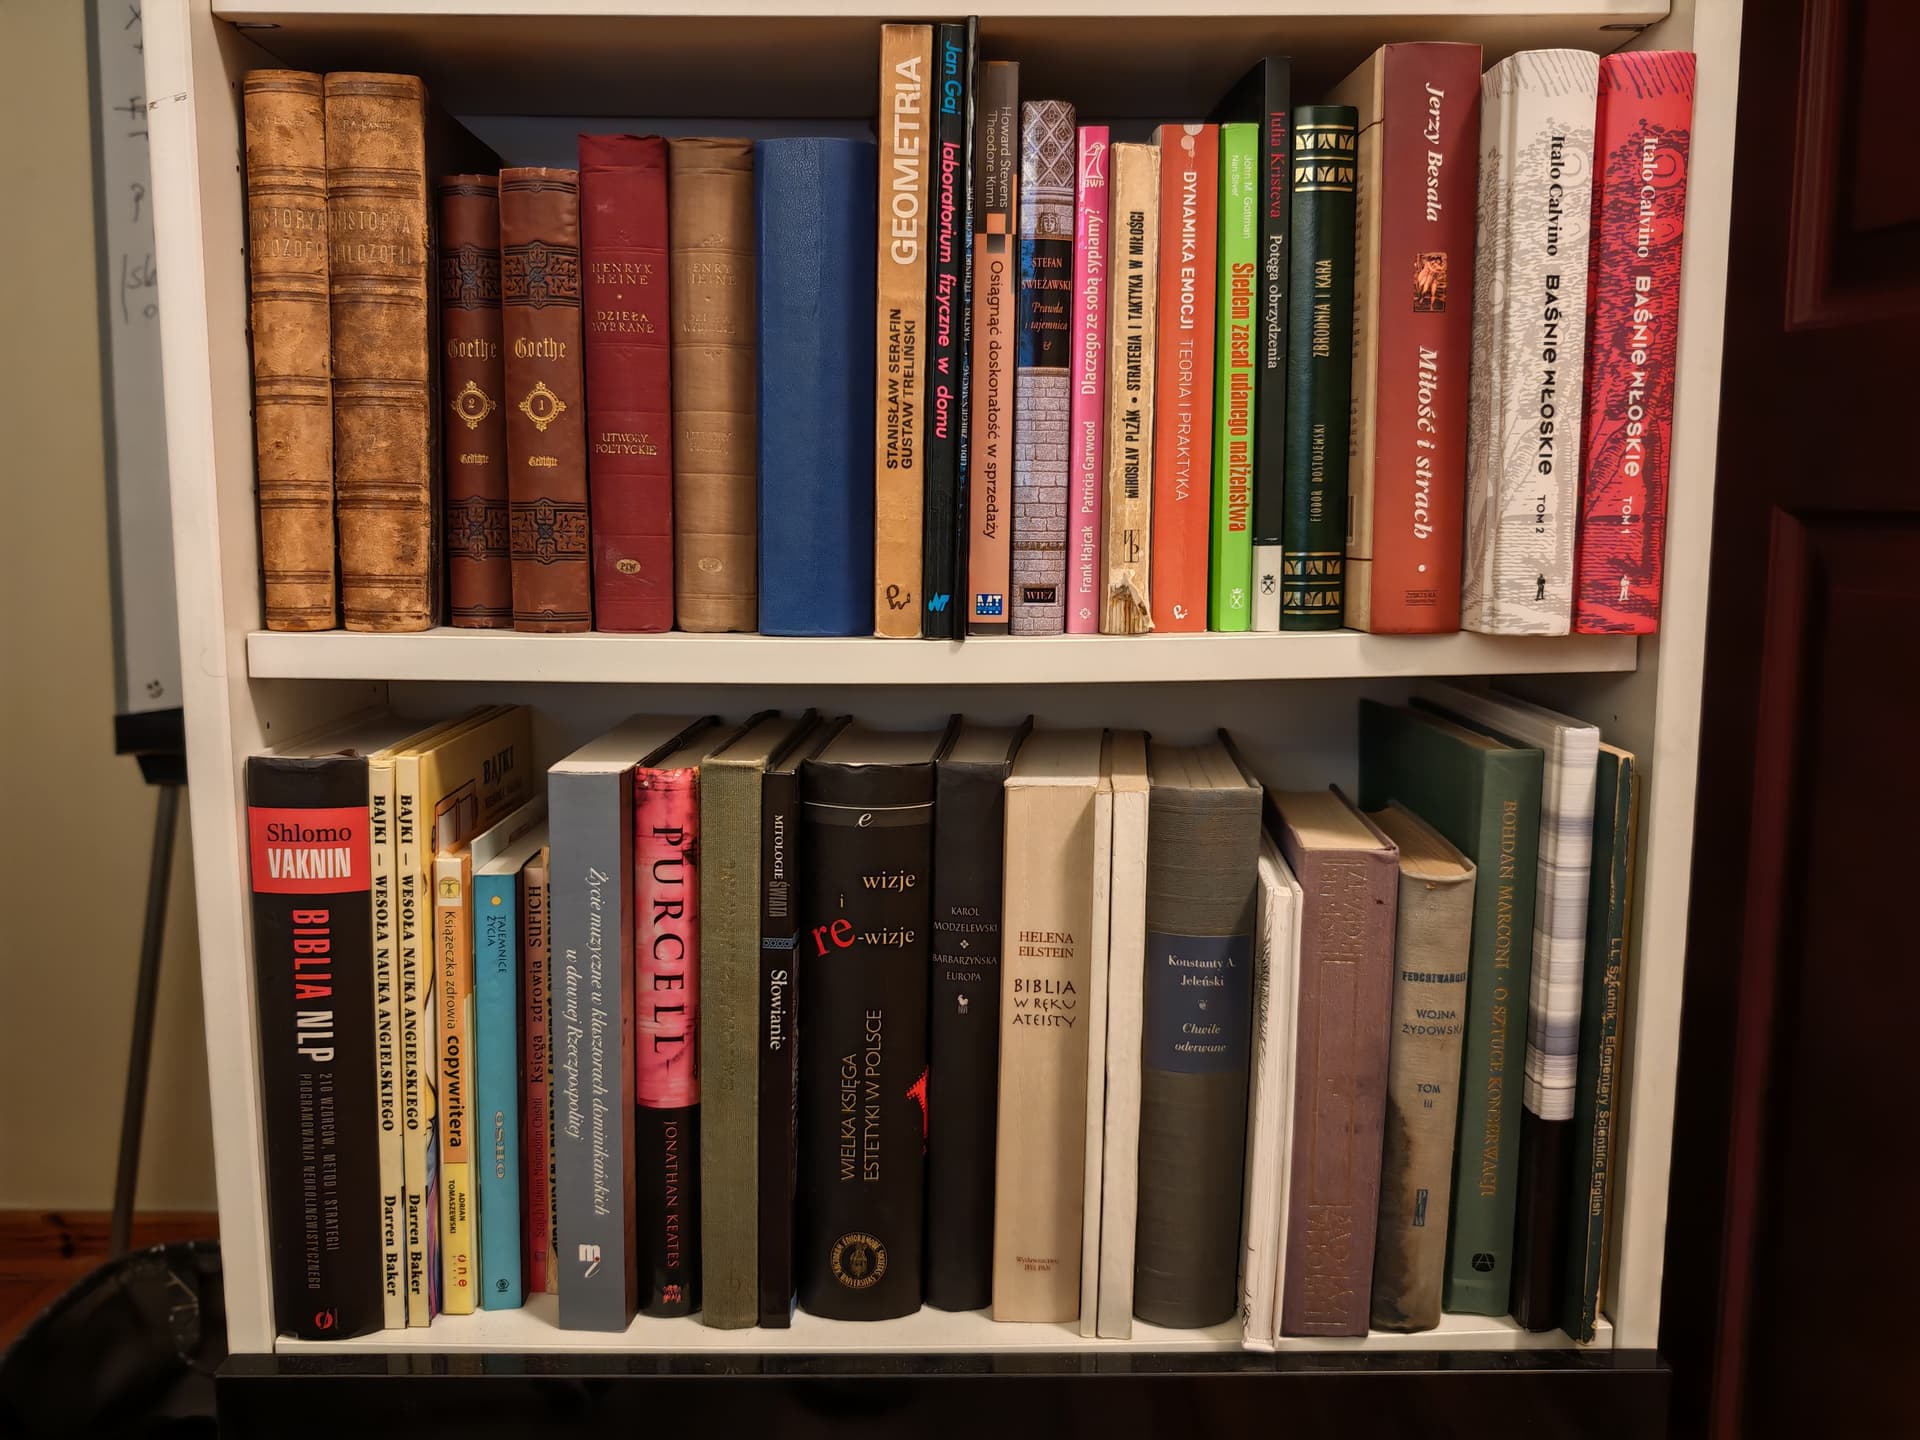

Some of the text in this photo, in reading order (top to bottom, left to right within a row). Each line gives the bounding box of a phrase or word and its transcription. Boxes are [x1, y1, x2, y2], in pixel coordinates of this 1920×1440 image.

[941, 40, 963, 115] Jan Gaj
[890, 56, 922, 265] GEOMETRIA
[985, 110, 998, 208] Theodore Kinni
[1000, 106, 1012, 208] Howard Stevens
[1423, 81, 1445, 223] Jerzy Besala
[1550, 135, 1566, 180] Italo
[1641, 136, 1659, 182] Italo
[1242, 197, 1253, 239] Gottman
[1546, 182, 1563, 257] Calvino
[1637, 185, 1656, 259] Calvino
[592, 263, 653, 275] HENRYK
[596, 274, 649, 286] HEINE
[936, 142, 961, 439] laboratorium fizyczne w domu
[1032, 257, 1062, 268] STEFAN
[1265, 153, 1286, 369] Kristeva Potęga obrzydzenia
[592, 321, 655, 334] WYBRANE
[597, 311, 649, 322] DZIEŁA
[1030, 319, 1068, 333] tajemnica
[1032, 301, 1064, 314] Prawda
[1080, 208, 1104, 395] Dlaczego ze sobą sypiamy?
[1312, 259, 1333, 358] ZBRODNIA KARA
[448, 338, 497, 361] Goethe
[514, 337, 567, 361] Goethe
[1121, 211, 1145, 498] MIROSLAV PLZÁK STRATEGIA TAKTYKA W MIŁOŚCI
[1175, 171, 1197, 502] DYNAMIKA EMOCJI TEORIA PRAKTYKA
[886, 308, 902, 470] STANISŁAW SERAFIN
[900, 320, 916, 470] GUSTAW TRELIŃSKI
[982, 260, 1004, 539] Osiągnąć doskonałość w sprzedaży
[1227, 263, 1255, 532] Siedem zasad udanego małżeństwa
[602, 432, 649, 443] UTWORY
[1081, 420, 1097, 513] Patricia Garwood
[1413, 345, 1438, 539] Miłość strach
[1310, 424, 1325, 522] FIODOR DOSTOJEWSKI
[1535, 494, 1546, 524] TOM
[1622, 495, 1633, 525] TOM
[1079, 525, 1096, 593] Frank Hajcak
[267, 823, 352, 843] Shlomo
[267, 847, 352, 880] VAKNIN
[768, 815, 791, 917] MITOLOGIE ŚWIATA
[1498, 800, 1518, 880] BOHDAN
[862, 870, 916, 893] wizje
[951, 906, 980, 917] KAROL
[486, 914, 496, 947] ŻYCIA
[497, 914, 507, 974] TAJEMNICE
[652, 824, 685, 1053] PURCELL
[811, 917, 915, 957] re-wizje
[932, 954, 998, 966] BARBARZYŃSKA
[934, 921, 998, 933] MODZELEWSKI
[1018, 946, 1074, 959] EILSTEIN
[1019, 931, 1074, 944] HELENA
[1494, 885, 1514, 969] MARCONI
[292, 909, 335, 1063] BIBLIA NLP
[528, 885, 546, 1084] Księga zdrowia SUFICH
[946, 972, 982, 982] EUROPA
[1014, 979, 1077, 995] BIBLIA
[1168, 954, 1224, 971] Konstanty
[1180, 974, 1225, 987] Jeleński
[443, 911, 465, 1148] Książeczka zdrowia copywritera
[769, 969, 788, 1050] Słowianie
[1012, 1014, 1077, 1028] ATEISTY
[1034, 997, 1077, 1012] RĘKU
[1182, 1023, 1222, 1035] Chwile
[1416, 1009, 1457, 1020] WOJNA
[371, 794, 398, 1297] BAJKI WESOŁA NAUKA ANGIELSKIEGO Darren Baker
[398, 794, 422, 1294] BAJKI WESOŁA NAUKA ANGIELSKIEGO Darren Baker
[562, 948, 585, 1141] w dawnej Rzeczpospolitej
[585, 866, 610, 1216] Życie muzyczne klasztorach dominikańskich
[1174, 1041, 1228, 1054] oderwane
[1489, 1005, 1508, 1073] SZTUCE
[841, 1053, 860, 1181] WIELKA KSIĘGA
[864, 1009, 882, 1181] ESTETYKI W POLSCE
[1416, 1083, 1441, 1094] TOM
[1591, 965, 1620, 1216] Szkutnik Elementary Scientific English
[318, 1073, 340, 1251] 210 METOD STRATEGII
[495, 1110, 506, 1179] OSHO
[299, 1073, 321, 1290] PROGRAMOWANIA NEUROLINGWISTYCZNEGO
[448, 1180, 457, 1234] TOMASZEWSKI
[458, 1192, 466, 1222] ADRIAN
[663, 1121, 680, 1268] JONATHAN KEATES
